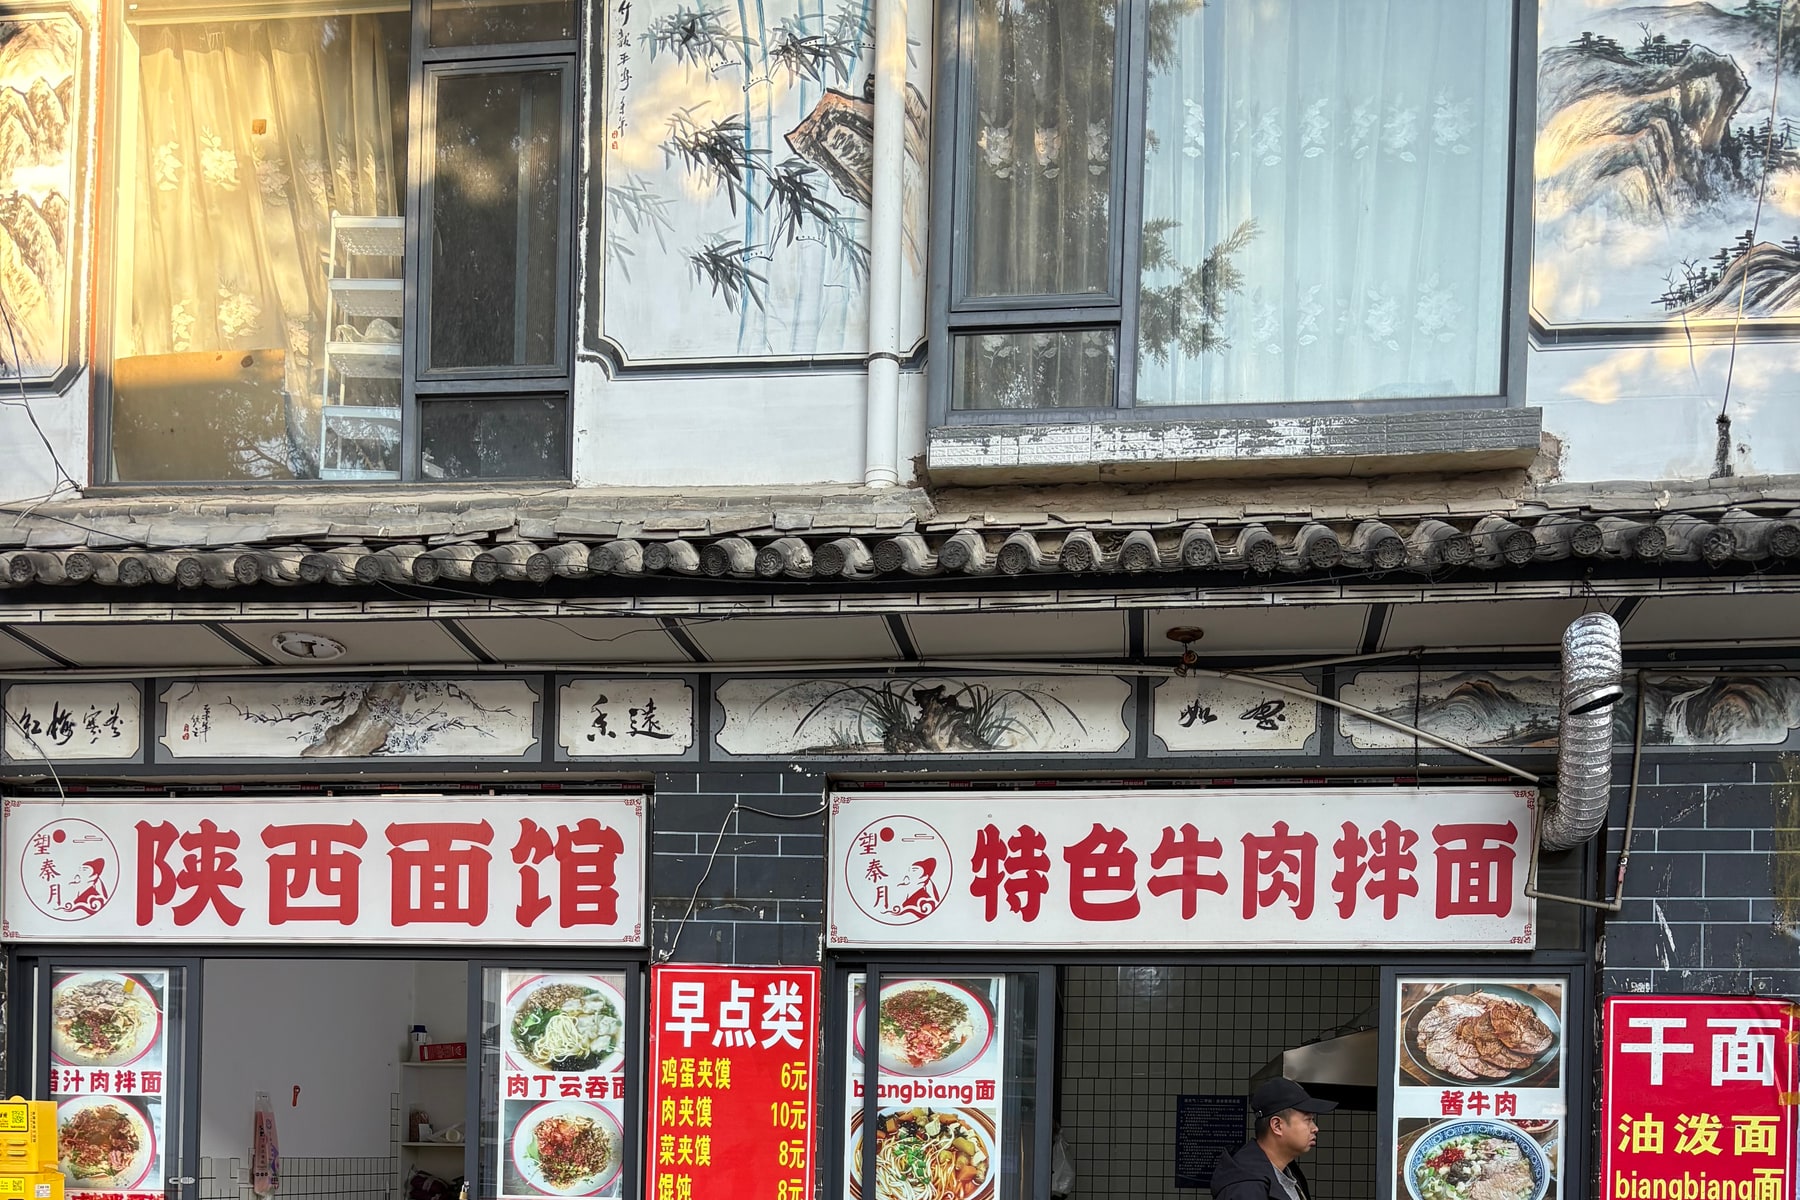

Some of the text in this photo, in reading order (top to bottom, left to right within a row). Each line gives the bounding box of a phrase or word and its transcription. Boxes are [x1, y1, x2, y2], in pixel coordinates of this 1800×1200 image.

[33, 833, 62, 907] 望秦月
[135, 818, 625, 928] 陕西面馆
[859, 832, 889, 909] 望秦月
[969, 820, 1518, 923] 特色牛肉拌面
[665, 979, 804, 1050] 早点类
[661, 1057, 808, 1092] 鸡蛋夹馍 6元
[1620, 1016, 1782, 1087] 干面
[661, 1096, 807, 1130] 肉夹馍 10元
[853, 1079, 996, 1104] bangbiang面
[1440, 1090, 1518, 1117] 酱牛肉
[659, 1134, 805, 1169] 菜夹馍 8元
[1618, 1113, 1781, 1156] 油泼面
